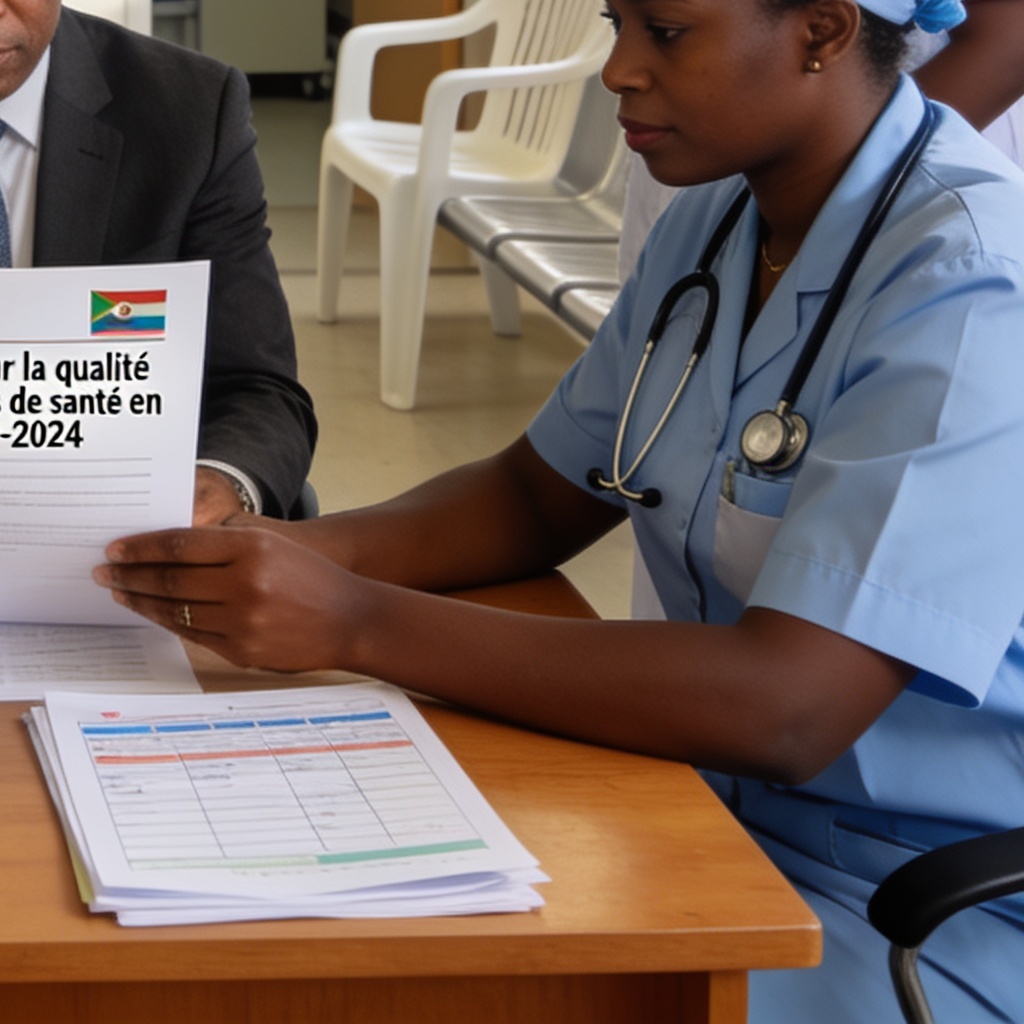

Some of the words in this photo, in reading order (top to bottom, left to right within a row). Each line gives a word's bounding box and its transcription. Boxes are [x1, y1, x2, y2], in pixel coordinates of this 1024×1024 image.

[23, 350, 46, 381] la
[55, 351, 150, 388] qualité
[9, 385, 42, 415] de
[49, 386, 122, 415] santé
[129, 393, 163, 415] en
